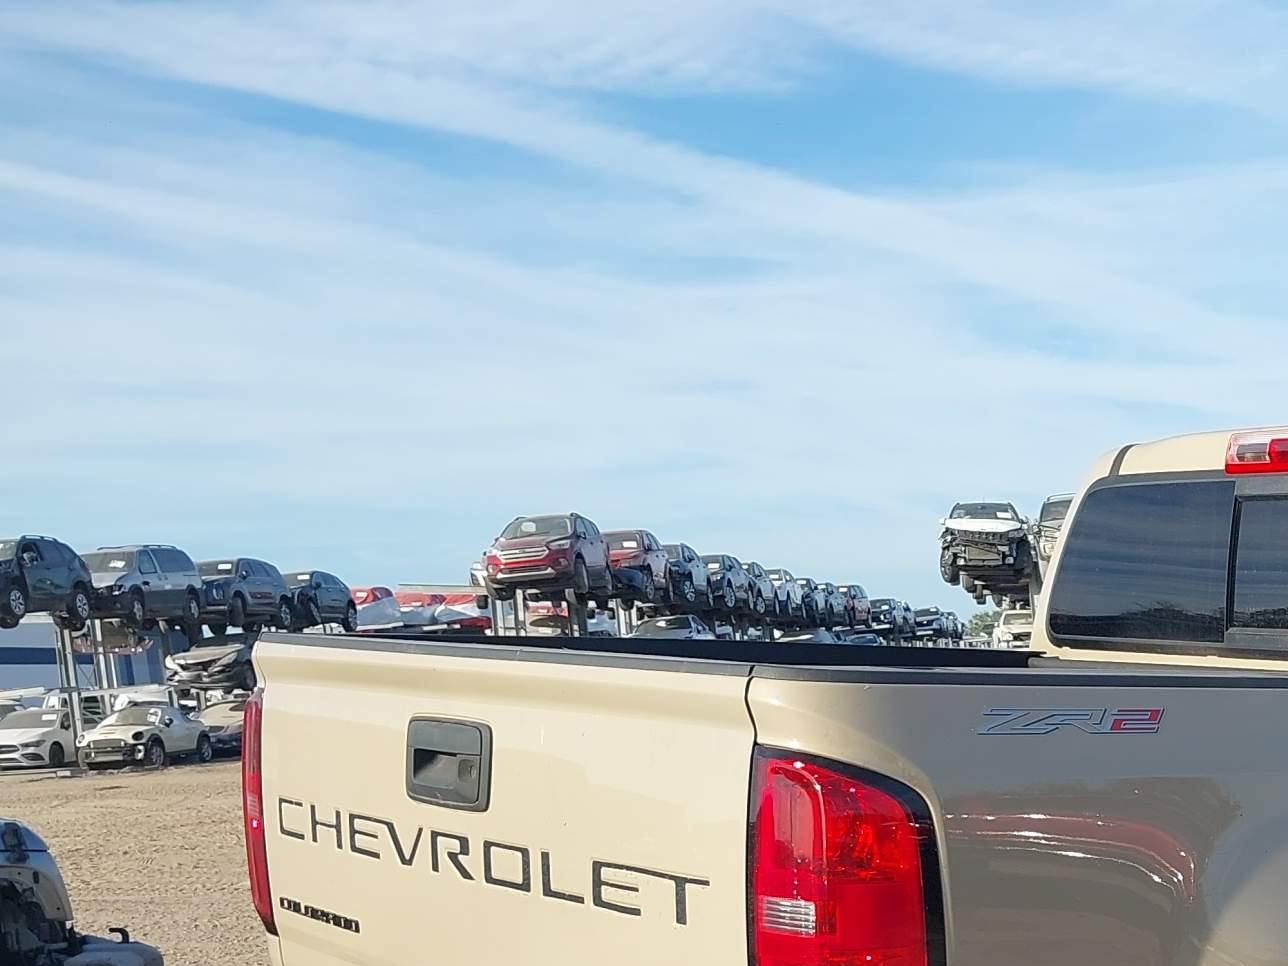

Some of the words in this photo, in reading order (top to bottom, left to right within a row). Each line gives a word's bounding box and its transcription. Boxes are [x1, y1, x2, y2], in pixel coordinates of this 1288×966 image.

[977, 706, 1165, 735] ZR2
[278, 797, 710, 926] CHEVROLET
[280, 896, 360, 934] COLORADO
